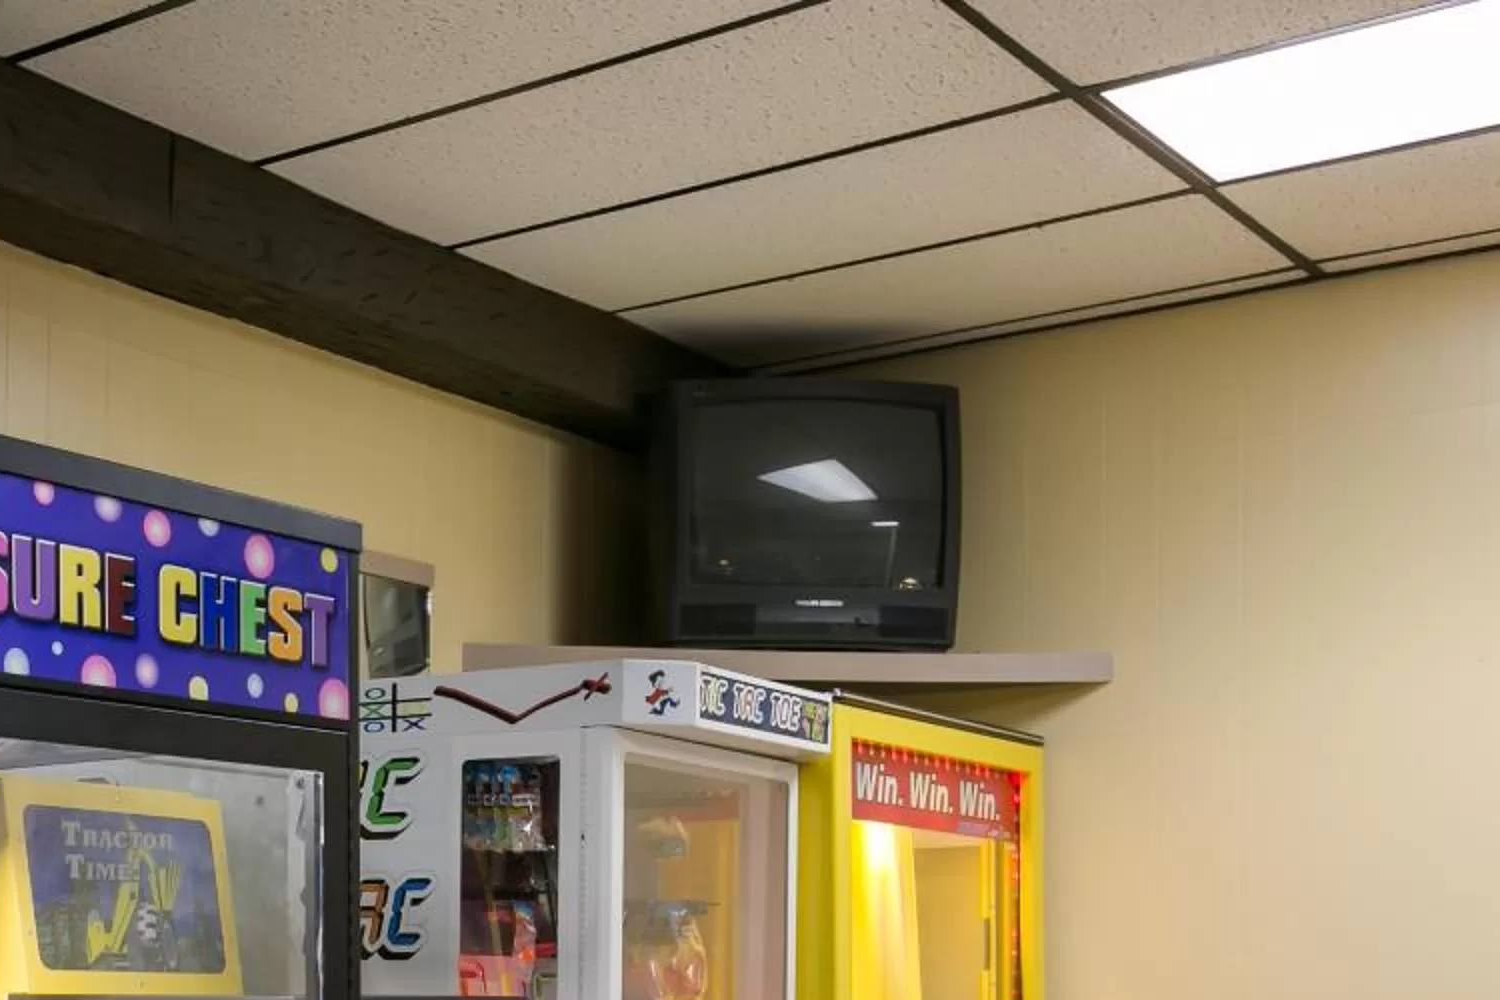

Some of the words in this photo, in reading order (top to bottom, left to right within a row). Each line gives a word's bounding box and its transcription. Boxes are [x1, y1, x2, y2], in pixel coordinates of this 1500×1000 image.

[157, 561, 336, 668] CHEST
[700, 675, 729, 717] TIC
[732, 682, 767, 724] TAC
[769, 691, 802, 732] TOE
[855, 760, 904, 805] Win.
[909, 770, 953, 814] Win.
[959, 780, 1000, 821] Win.
